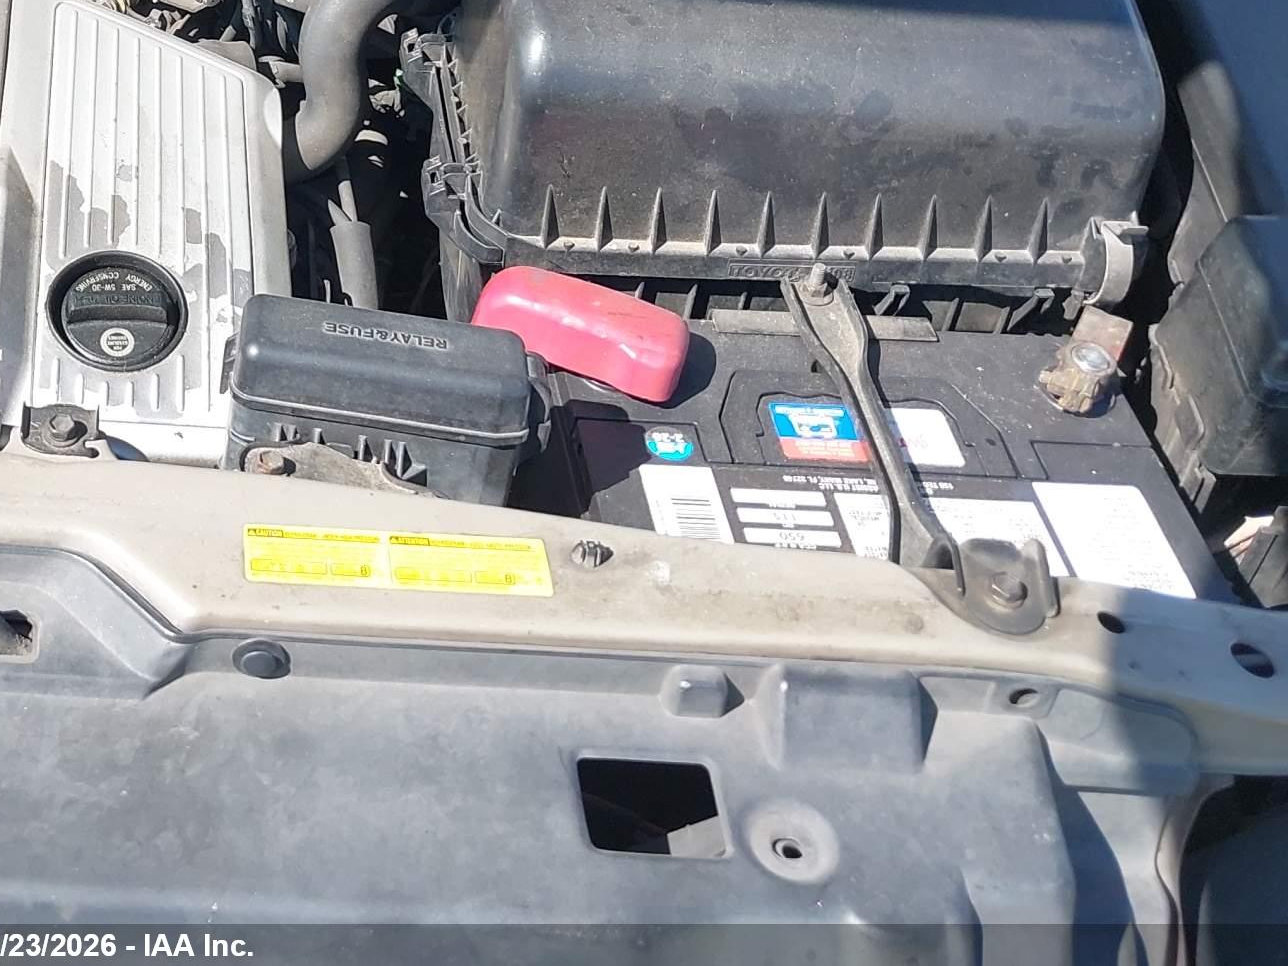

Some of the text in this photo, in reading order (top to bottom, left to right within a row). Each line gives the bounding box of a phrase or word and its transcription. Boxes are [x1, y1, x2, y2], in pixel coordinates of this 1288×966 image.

[75, 271, 154, 292] ENERGY CONSERVING
[121, 283, 137, 292] SAE
[324, 320, 449, 350] RELAY&FUSE
[256, 529, 283, 538] CAUTION
